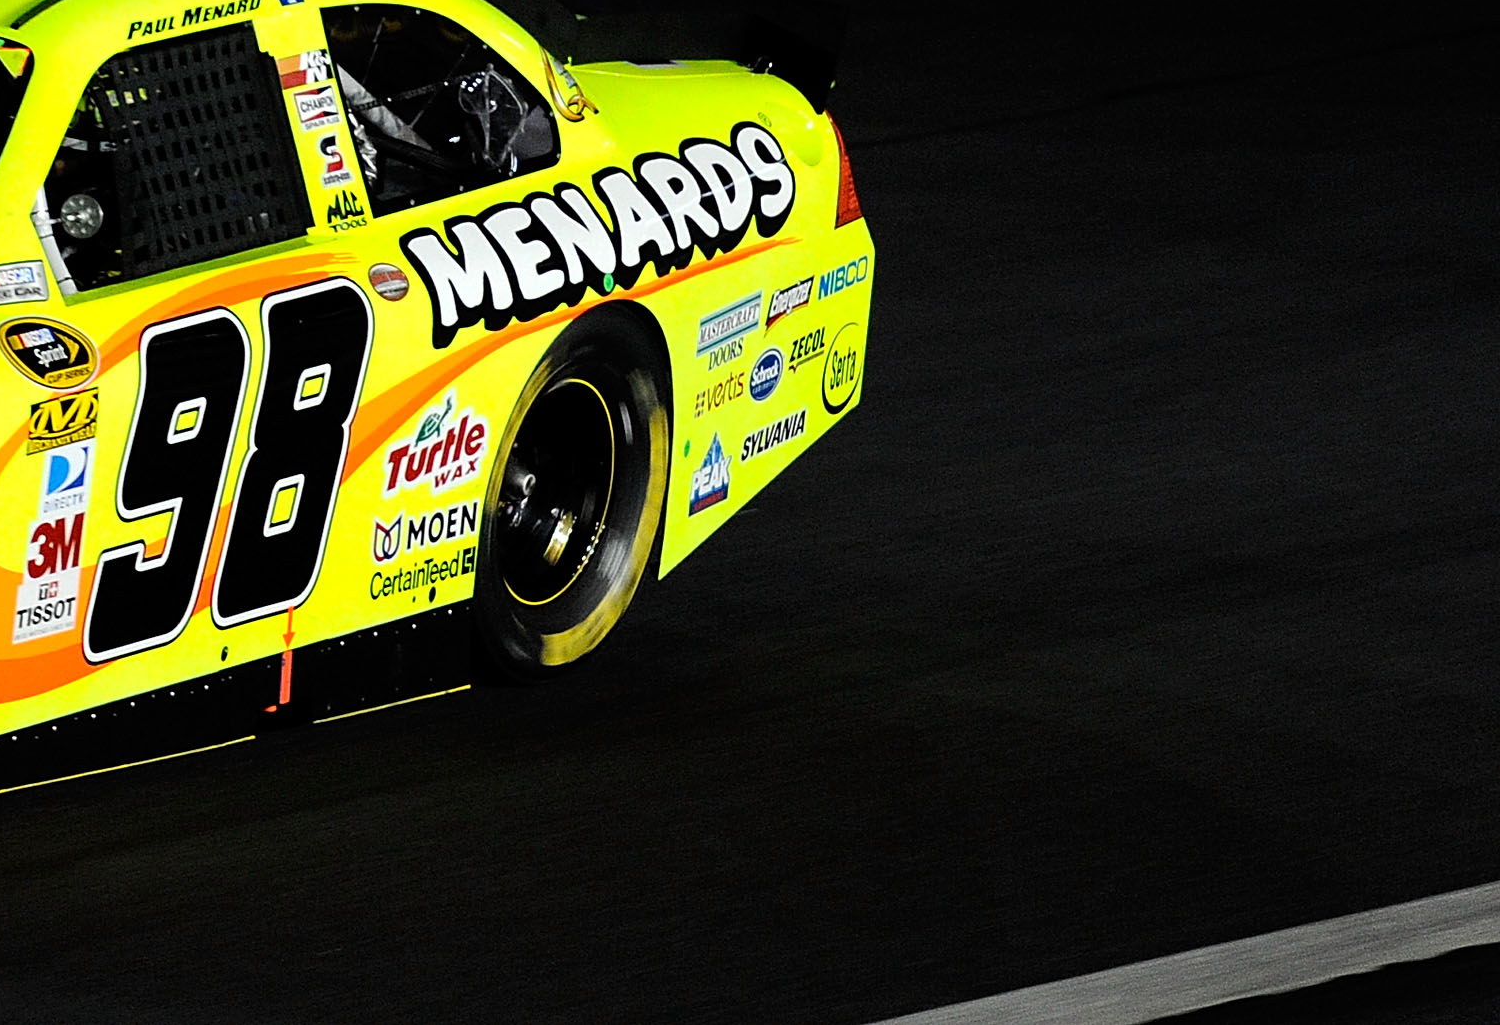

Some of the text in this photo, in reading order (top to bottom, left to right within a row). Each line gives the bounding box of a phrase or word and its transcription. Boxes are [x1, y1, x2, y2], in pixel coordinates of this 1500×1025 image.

[127, 13, 176, 40] PAUL
[327, 189, 365, 224] MAC
[328, 217, 368, 233] TOOLS
[404, 124, 794, 332] MENARDS
[14, 286, 43, 297] CAR
[818, 255, 869, 301] NIBCO
[699, 302, 760, 345] MASTERCRAFT
[789, 327, 826, 361] ZECOL
[33, 343, 69, 368] Sprint
[708, 337, 744, 372] DOORS
[829, 346, 858, 391] Serta
[706, 371, 745, 412] vertis
[386, 414, 485, 492] Turtle
[741, 410, 807, 462] SYLVANIA
[83, 277, 374, 664] 98
[434, 457, 478, 489] WAX
[690, 454, 733, 499] PEAK
[26, 511, 86, 579] 3M
[406, 502, 478, 550] MOEN
[370, 550, 461, 601] CertainTeed
[17, 597, 76, 629] TISSOT
